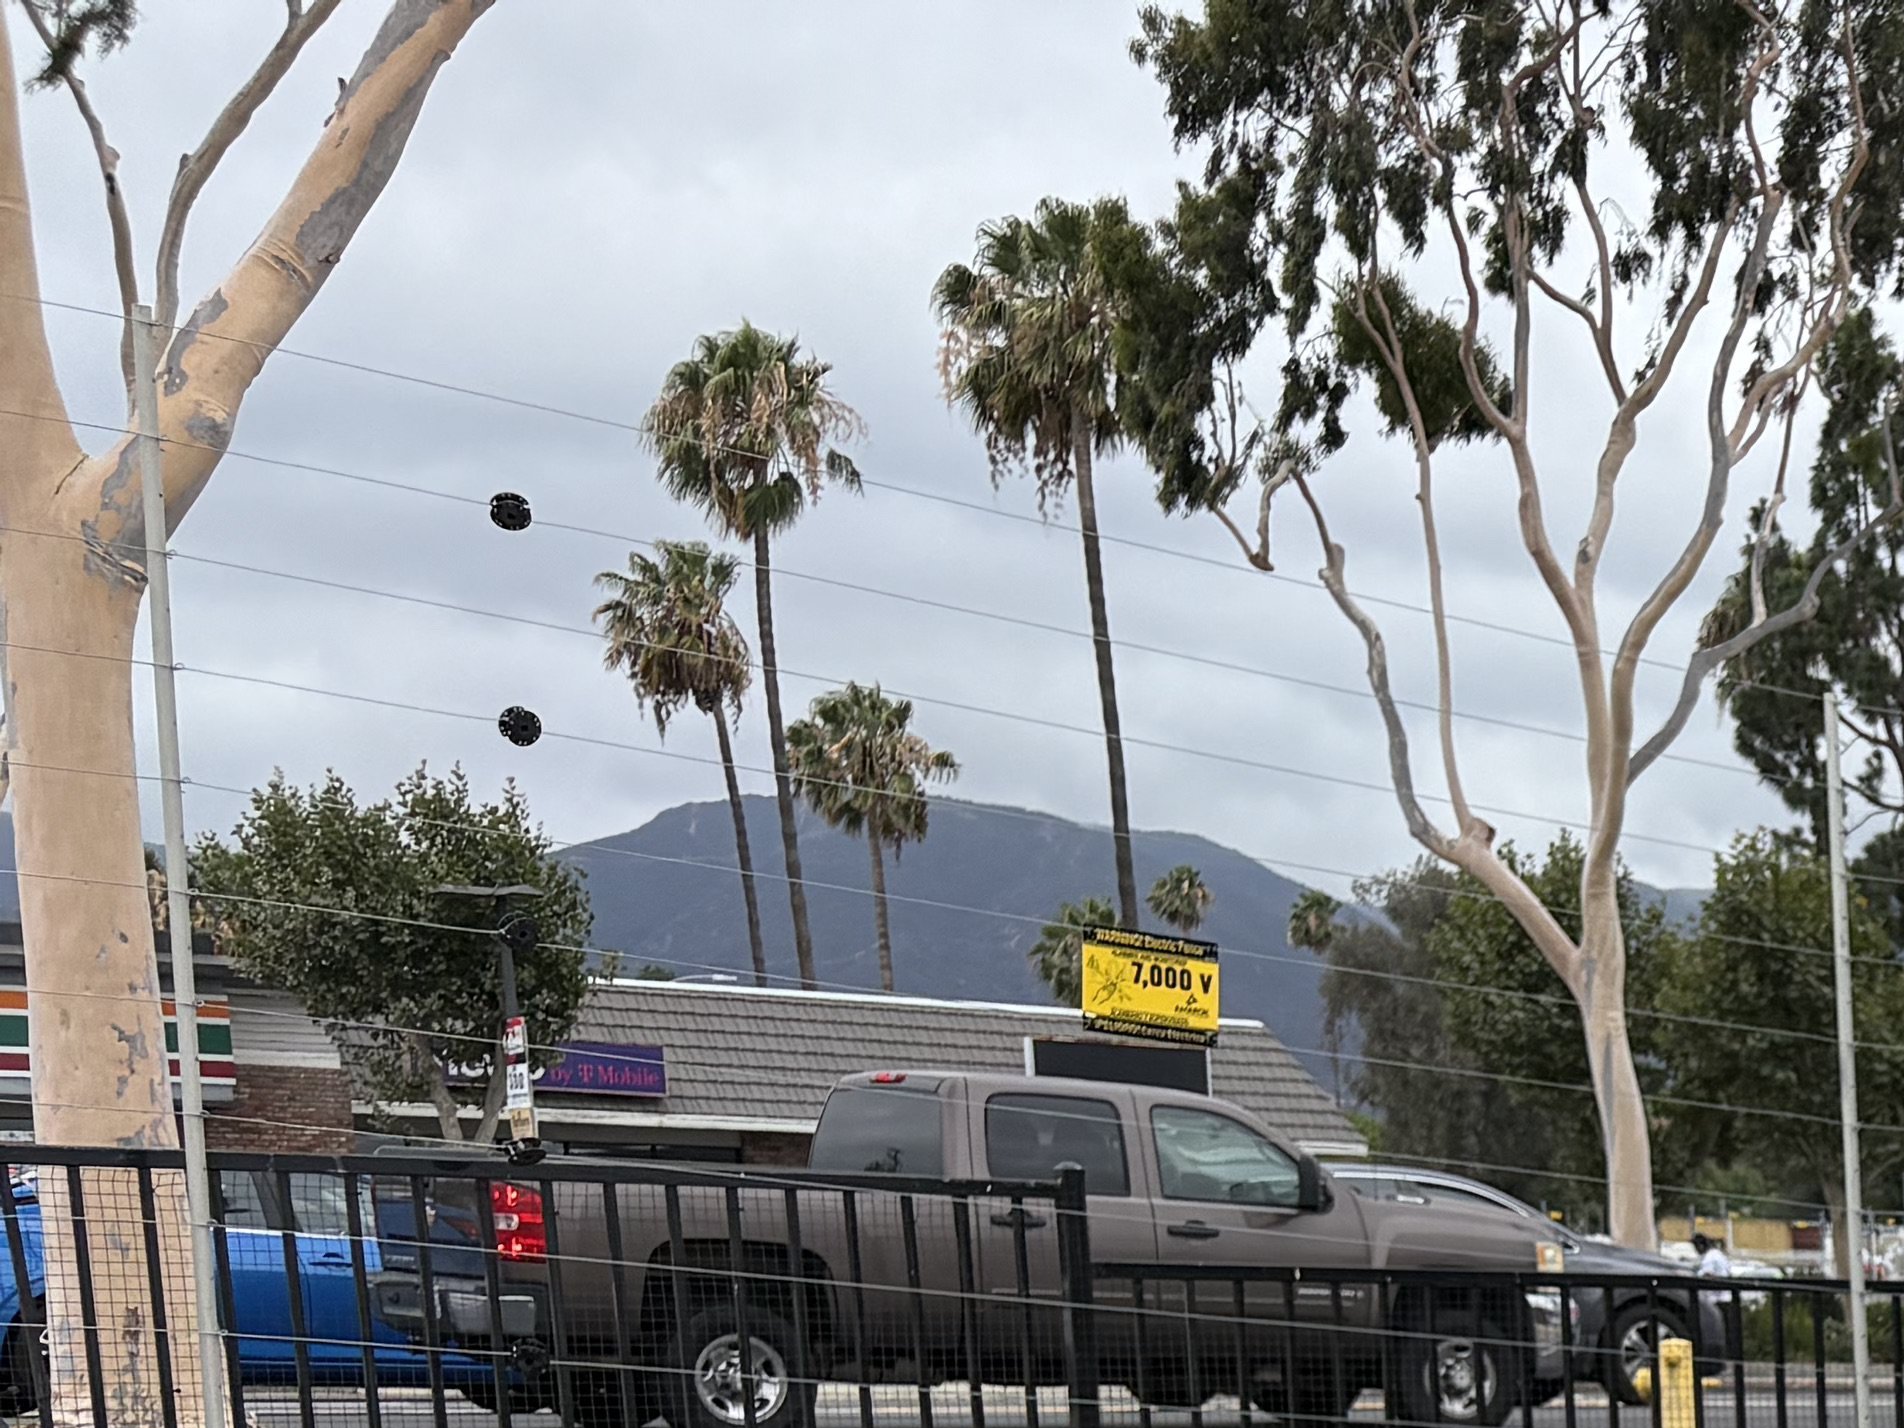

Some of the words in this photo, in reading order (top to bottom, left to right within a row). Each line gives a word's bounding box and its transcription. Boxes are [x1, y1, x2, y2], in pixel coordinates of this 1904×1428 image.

[1131, 960, 1192, 992] 7,000
[1199, 973, 1213, 995] V
[599, 1064, 659, 1086] Mobile
